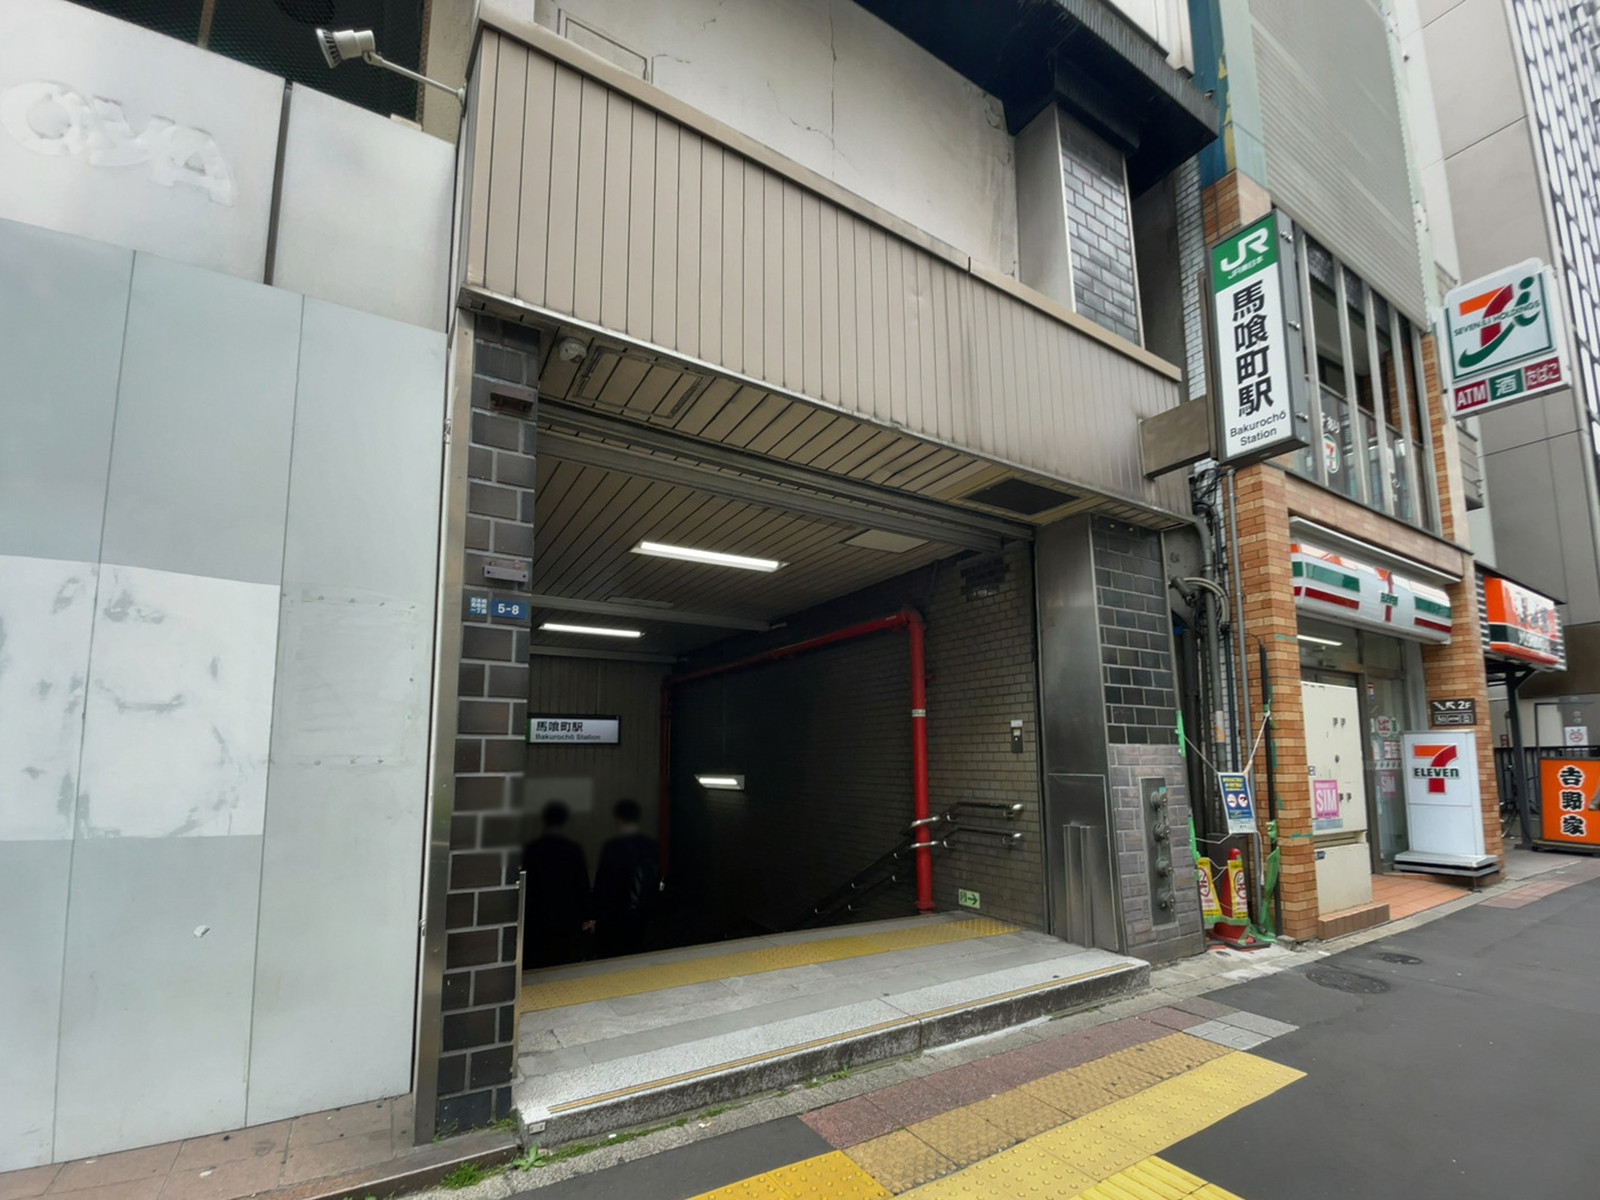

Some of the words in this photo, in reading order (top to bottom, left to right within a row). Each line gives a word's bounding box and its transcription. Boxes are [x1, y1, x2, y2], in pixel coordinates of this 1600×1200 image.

[1221, 227, 1269, 271] JR
[1232, 279, 1274, 418] 馬喰町駅
[1494, 373, 1518, 397] 酒
[1525, 362, 1560, 386] たばこ
[1456, 384, 1487, 408] ATM
[1240, 428, 1277, 446] Station
[497, 603, 520, 615] 5-8
[1458, 701, 1472, 709] 2F
[536, 721, 583, 732] 馬喰町駅
[1315, 789, 1338, 811] SIM
[1559, 766, 1586, 836] 吉野家
